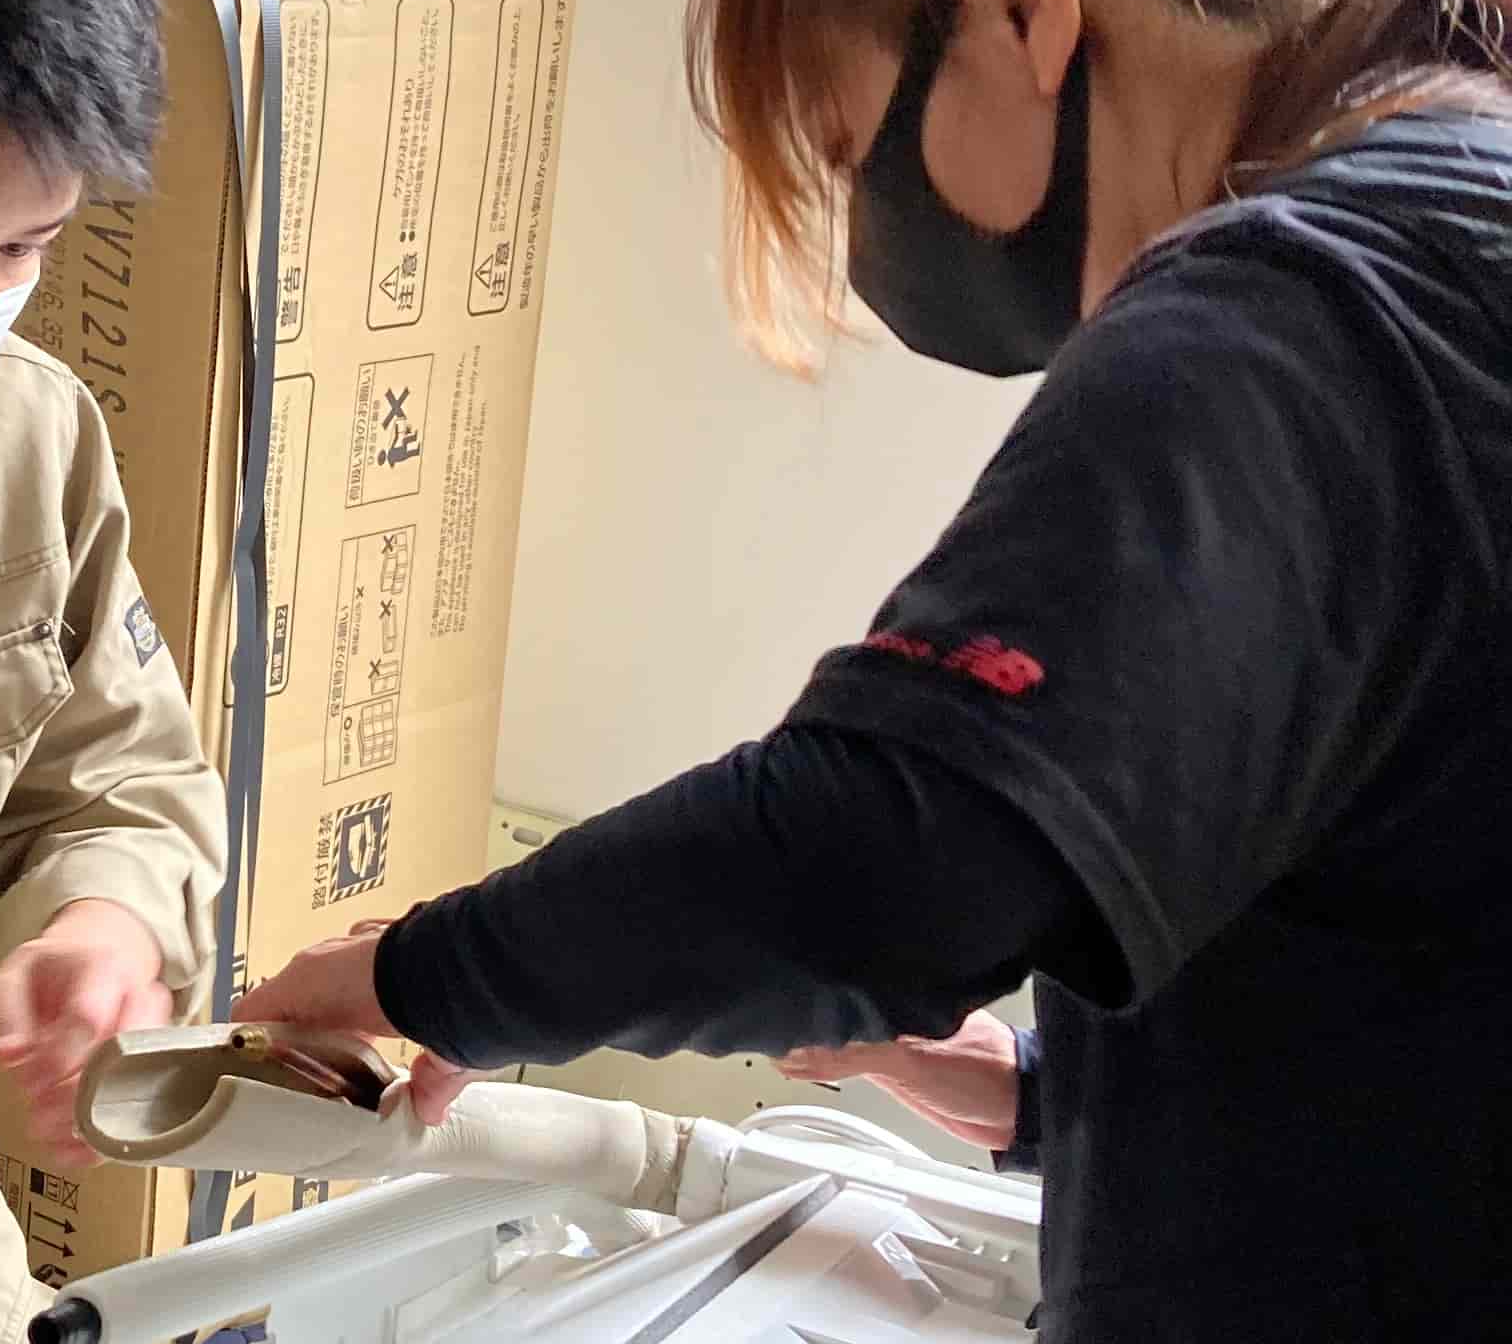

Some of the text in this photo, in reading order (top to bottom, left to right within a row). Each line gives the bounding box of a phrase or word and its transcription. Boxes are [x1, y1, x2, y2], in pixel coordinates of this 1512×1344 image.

[279, 265, 301, 327] 警告
[396, 251, 418, 311] 注意
[489, 240, 511, 298] 注意
[274, 606, 287, 639] R32
